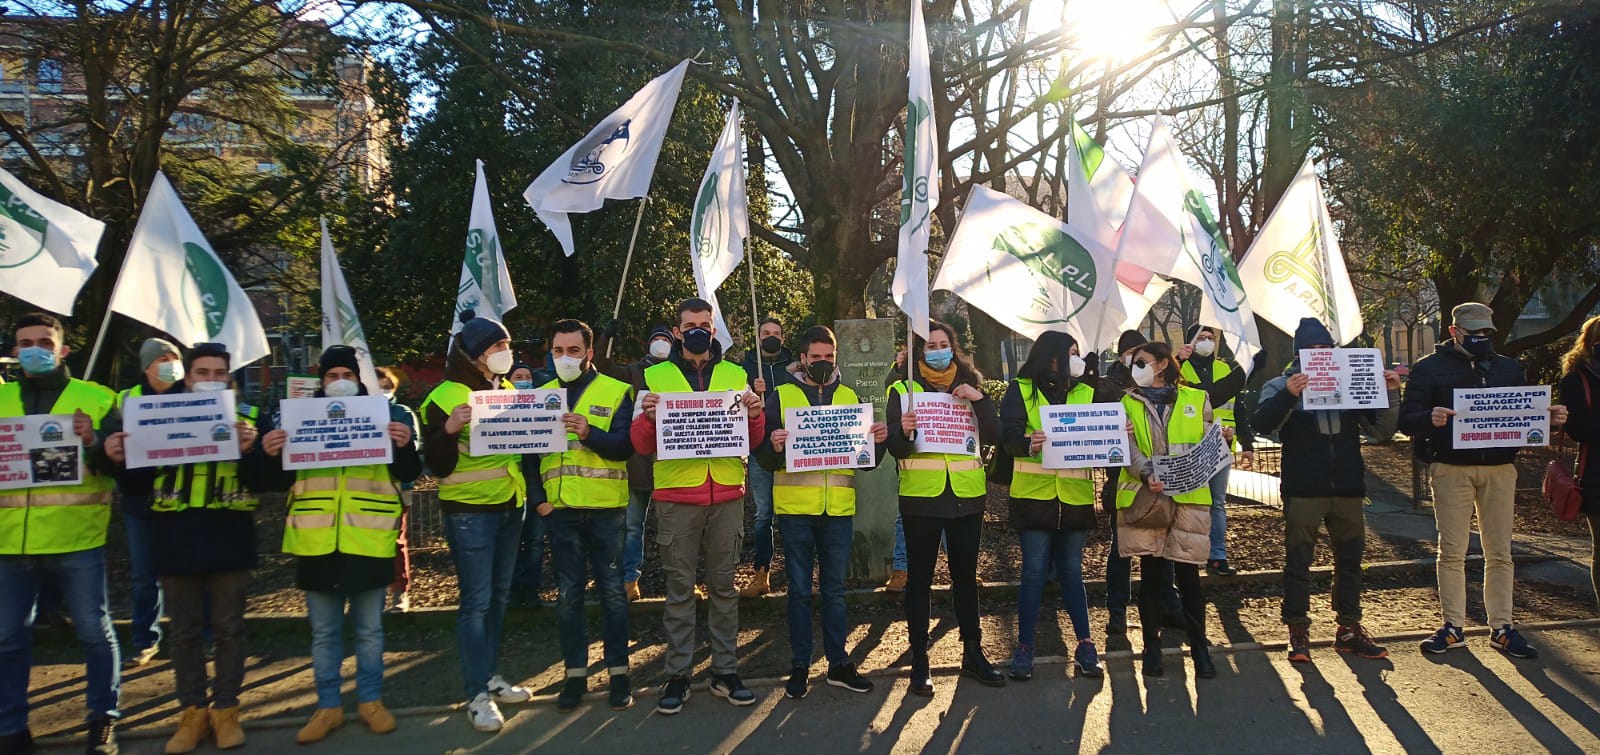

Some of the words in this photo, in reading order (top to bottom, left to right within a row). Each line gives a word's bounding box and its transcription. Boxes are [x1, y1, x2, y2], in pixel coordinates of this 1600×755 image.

[475, 395, 482, 404] 15
[485, 394, 514, 404] GENNAIO
[517, 394, 535, 403] 2022
[666, 400, 673, 409] 15
[676, 399, 703, 408] GENNAIO
[706, 398, 723, 408] 2022
[811, 408, 863, 416] DEDIZIONE
[818, 414, 857, 422] NOSTRO
[932, 423, 976, 432] DELL'ARROGANZA
[290, 435, 318, 443] LOCALE
[796, 433, 864, 442] PRESCINDERE
[1461, 432, 1491, 441] RIFORMA
[803, 446, 855, 455] SICUREZZA
[794, 458, 822, 468] RIFORMA
